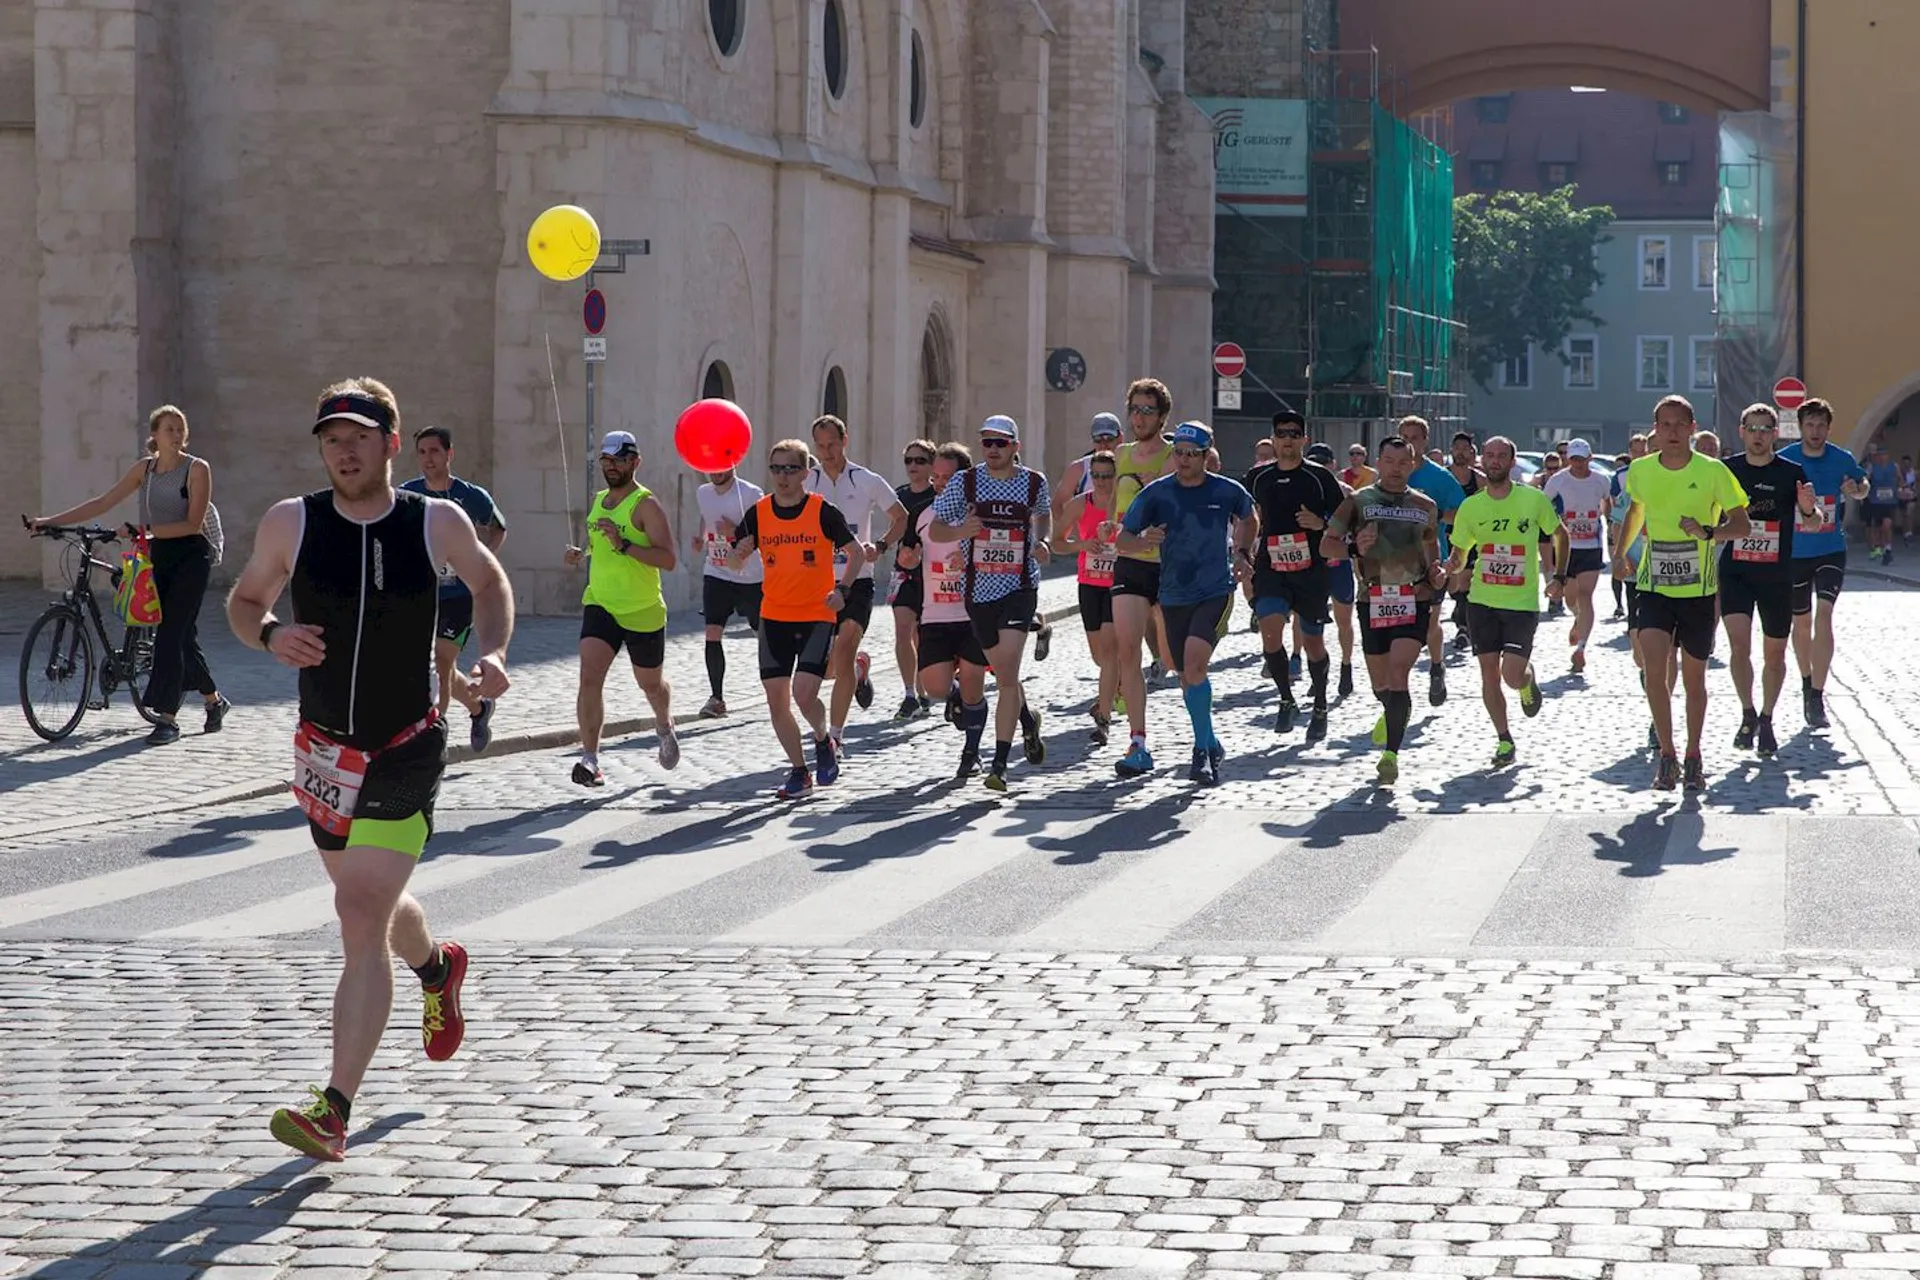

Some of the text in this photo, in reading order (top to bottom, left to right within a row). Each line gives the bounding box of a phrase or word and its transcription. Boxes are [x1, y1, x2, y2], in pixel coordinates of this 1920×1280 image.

[992, 504, 1013, 515] LLC
[1492, 518, 1510, 532] 27
[1741, 538, 1770, 551] 2327
[982, 549, 1015, 562] 3256
[1277, 550, 1303, 562] 4168
[1489, 562, 1517, 575] 4227
[1659, 561, 1691, 575] 2069
[1378, 605, 1408, 616] 3052
[303, 767, 341, 810] 2323
